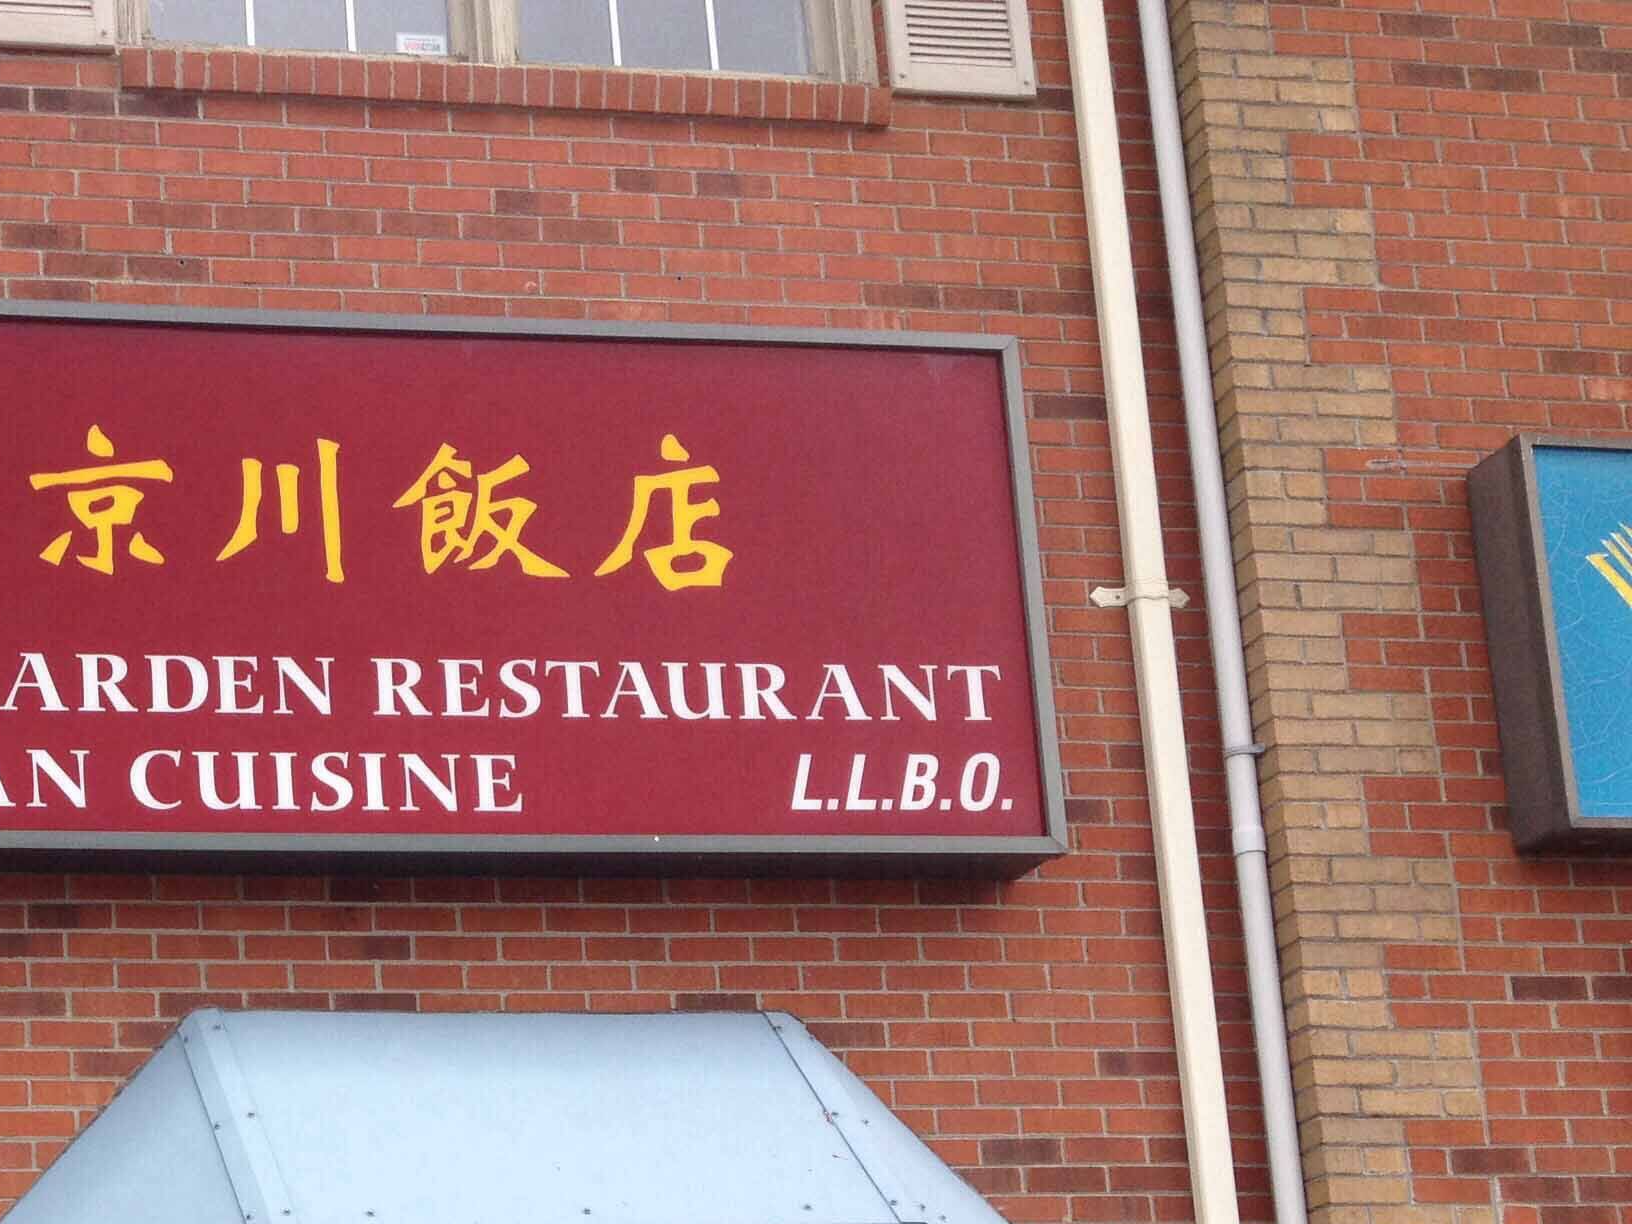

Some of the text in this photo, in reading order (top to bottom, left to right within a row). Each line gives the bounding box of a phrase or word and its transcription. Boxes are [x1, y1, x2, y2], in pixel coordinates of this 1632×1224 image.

[29, 424, 734, 592] 京川飯店
[370, 657, 1001, 722] RESTAURANT
[129, 749, 525, 813] CUISINE
[791, 752, 1013, 812] L.L.B.O.
